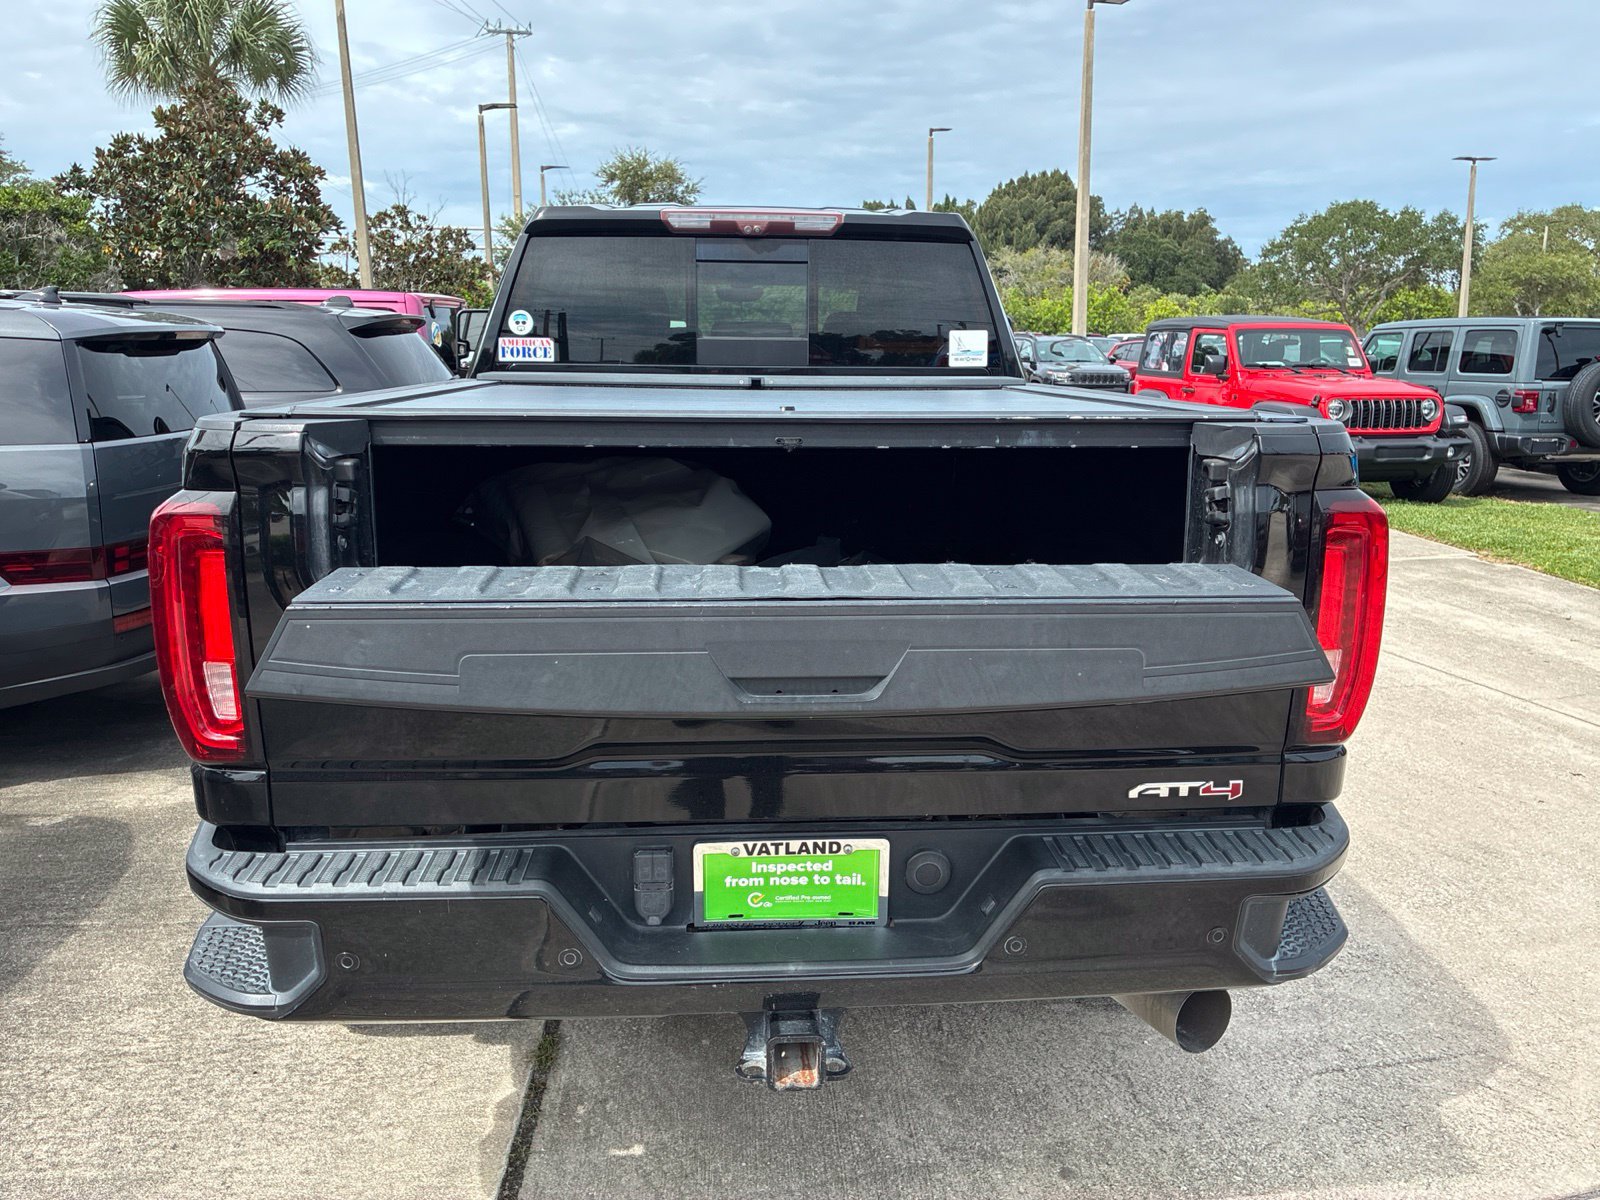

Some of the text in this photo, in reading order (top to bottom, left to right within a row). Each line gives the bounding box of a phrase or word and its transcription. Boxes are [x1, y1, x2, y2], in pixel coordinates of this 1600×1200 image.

[501, 346, 552, 358] FORCE
[1128, 780, 1243, 800] AT4
[743, 841, 842, 856] VATLAND
[751, 860, 833, 875] Inspected
[724, 872, 867, 888] from nose to tail.
